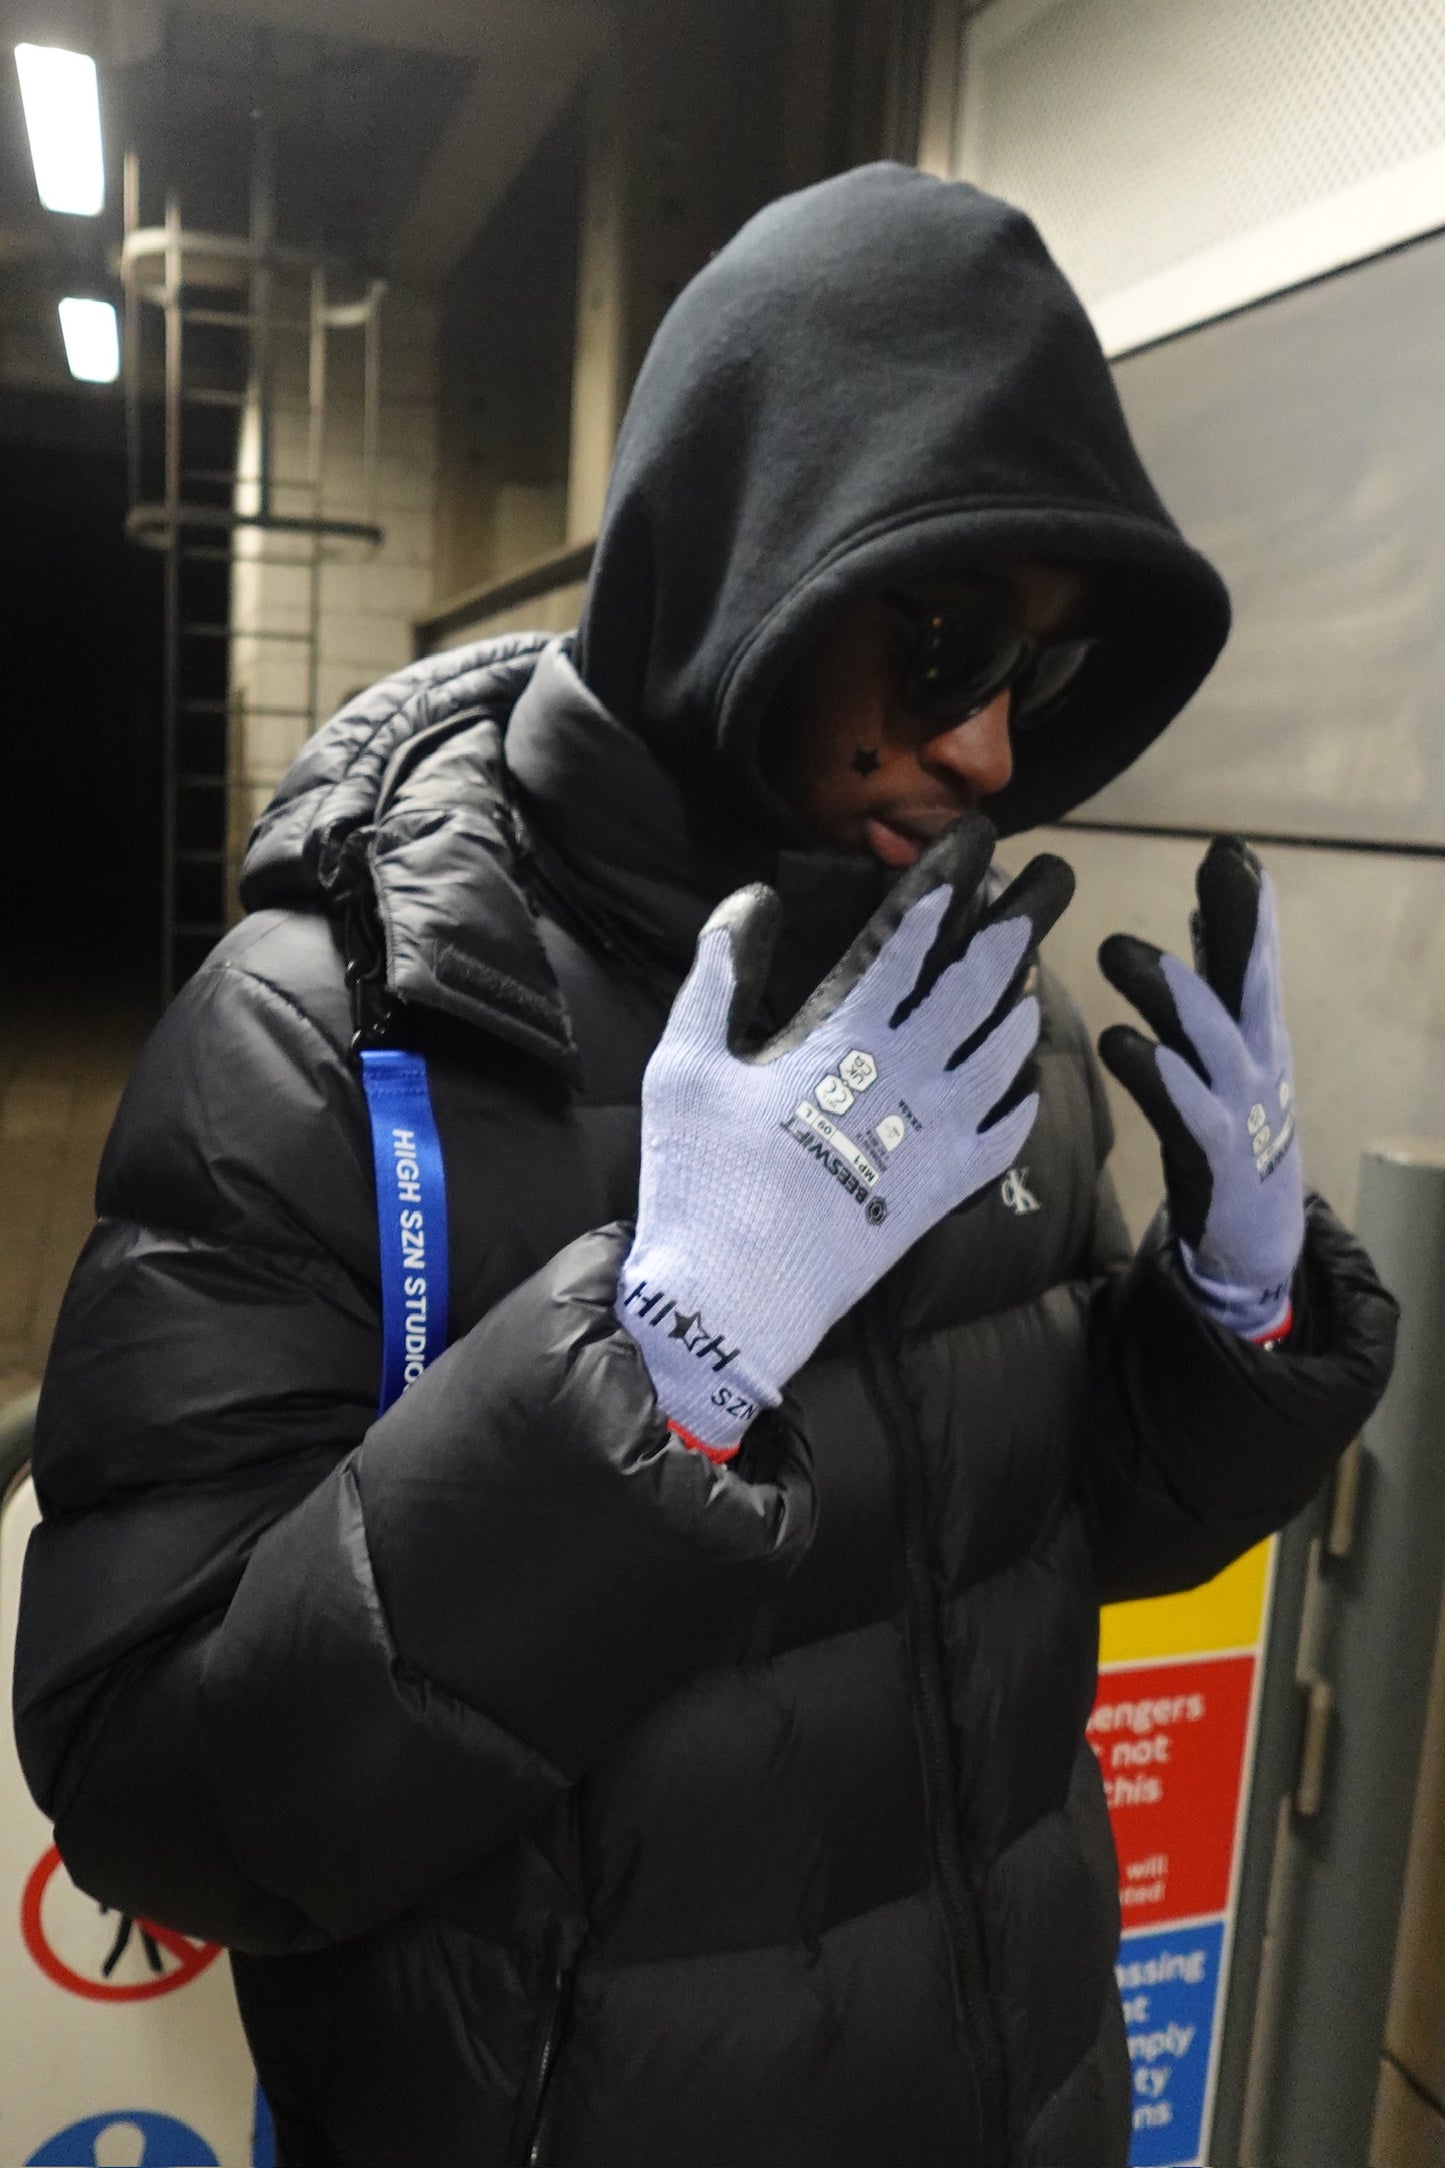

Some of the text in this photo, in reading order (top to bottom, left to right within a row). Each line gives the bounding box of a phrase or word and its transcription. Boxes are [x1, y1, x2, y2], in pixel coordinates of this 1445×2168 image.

[780, 1117, 869, 1205] BEESWIFT
[392, 1128, 427, 1394] HIGH SZN STUDIO
[711, 1387, 757, 1420] SZN
[1085, 1694, 1204, 1734] engers
[1111, 1735, 1170, 1766] not
